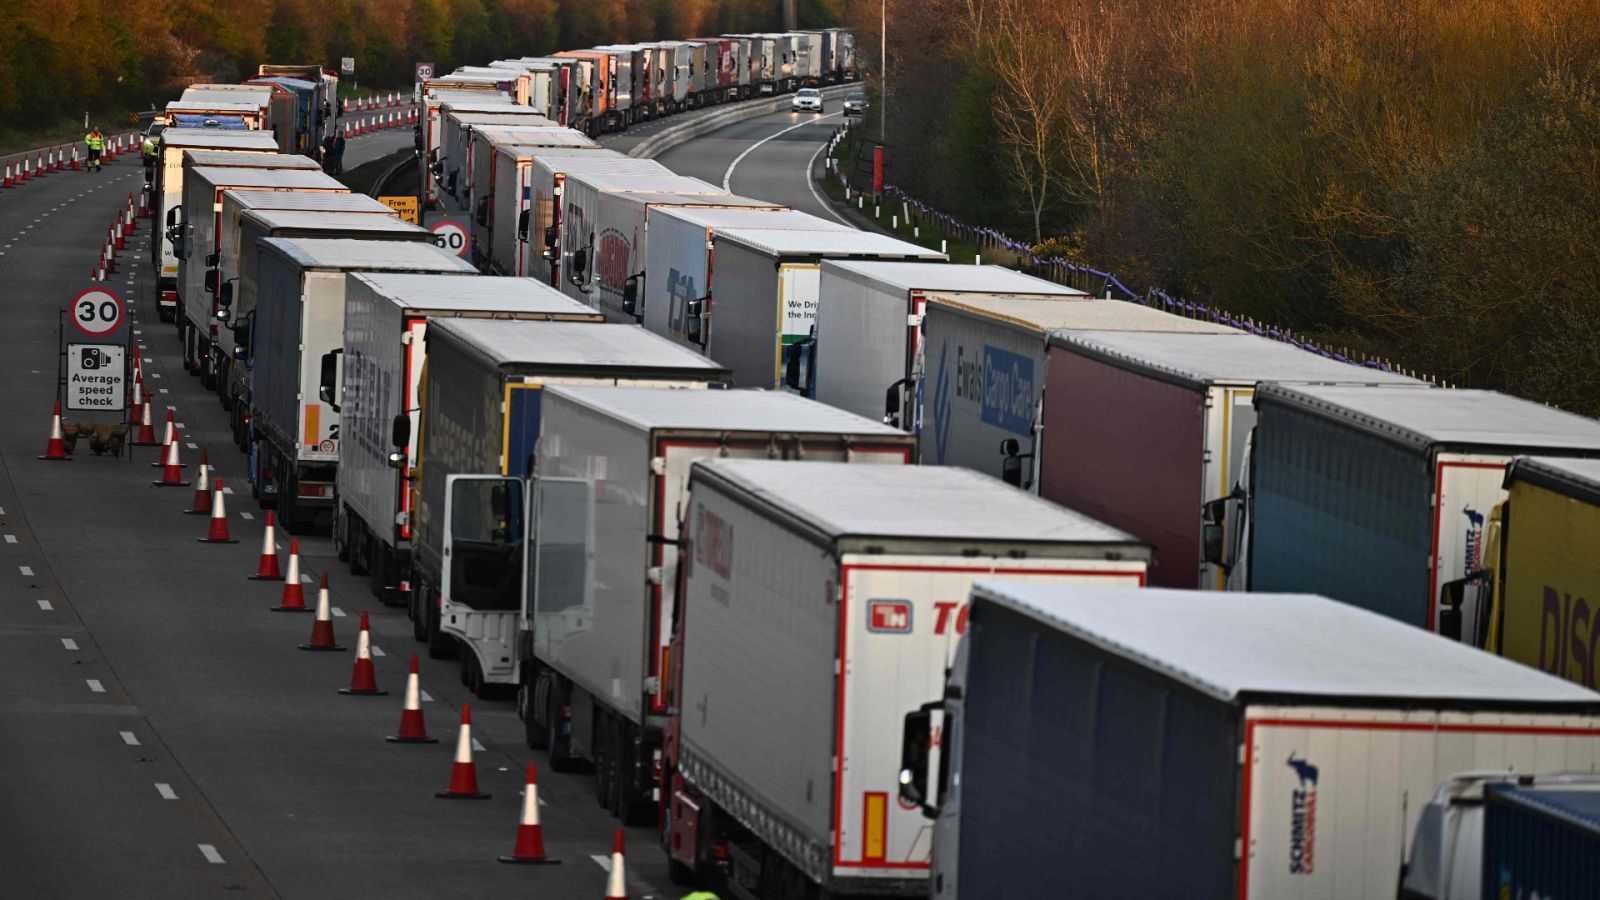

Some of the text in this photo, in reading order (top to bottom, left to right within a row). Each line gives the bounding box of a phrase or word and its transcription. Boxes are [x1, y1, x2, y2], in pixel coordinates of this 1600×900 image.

[788, 300, 819, 309] We Dri
[78, 301, 118, 322] 30
[788, 311, 817, 319] the Inn
[72, 373, 121, 385] Average
[956, 345, 1033, 424] Ewals Cargo Care
[78, 386, 113, 396] speed
[79, 396, 113, 406] check
[1290, 788, 1306, 875] SCHMITZ
[1304, 788, 1317, 876] CARGOBULL
